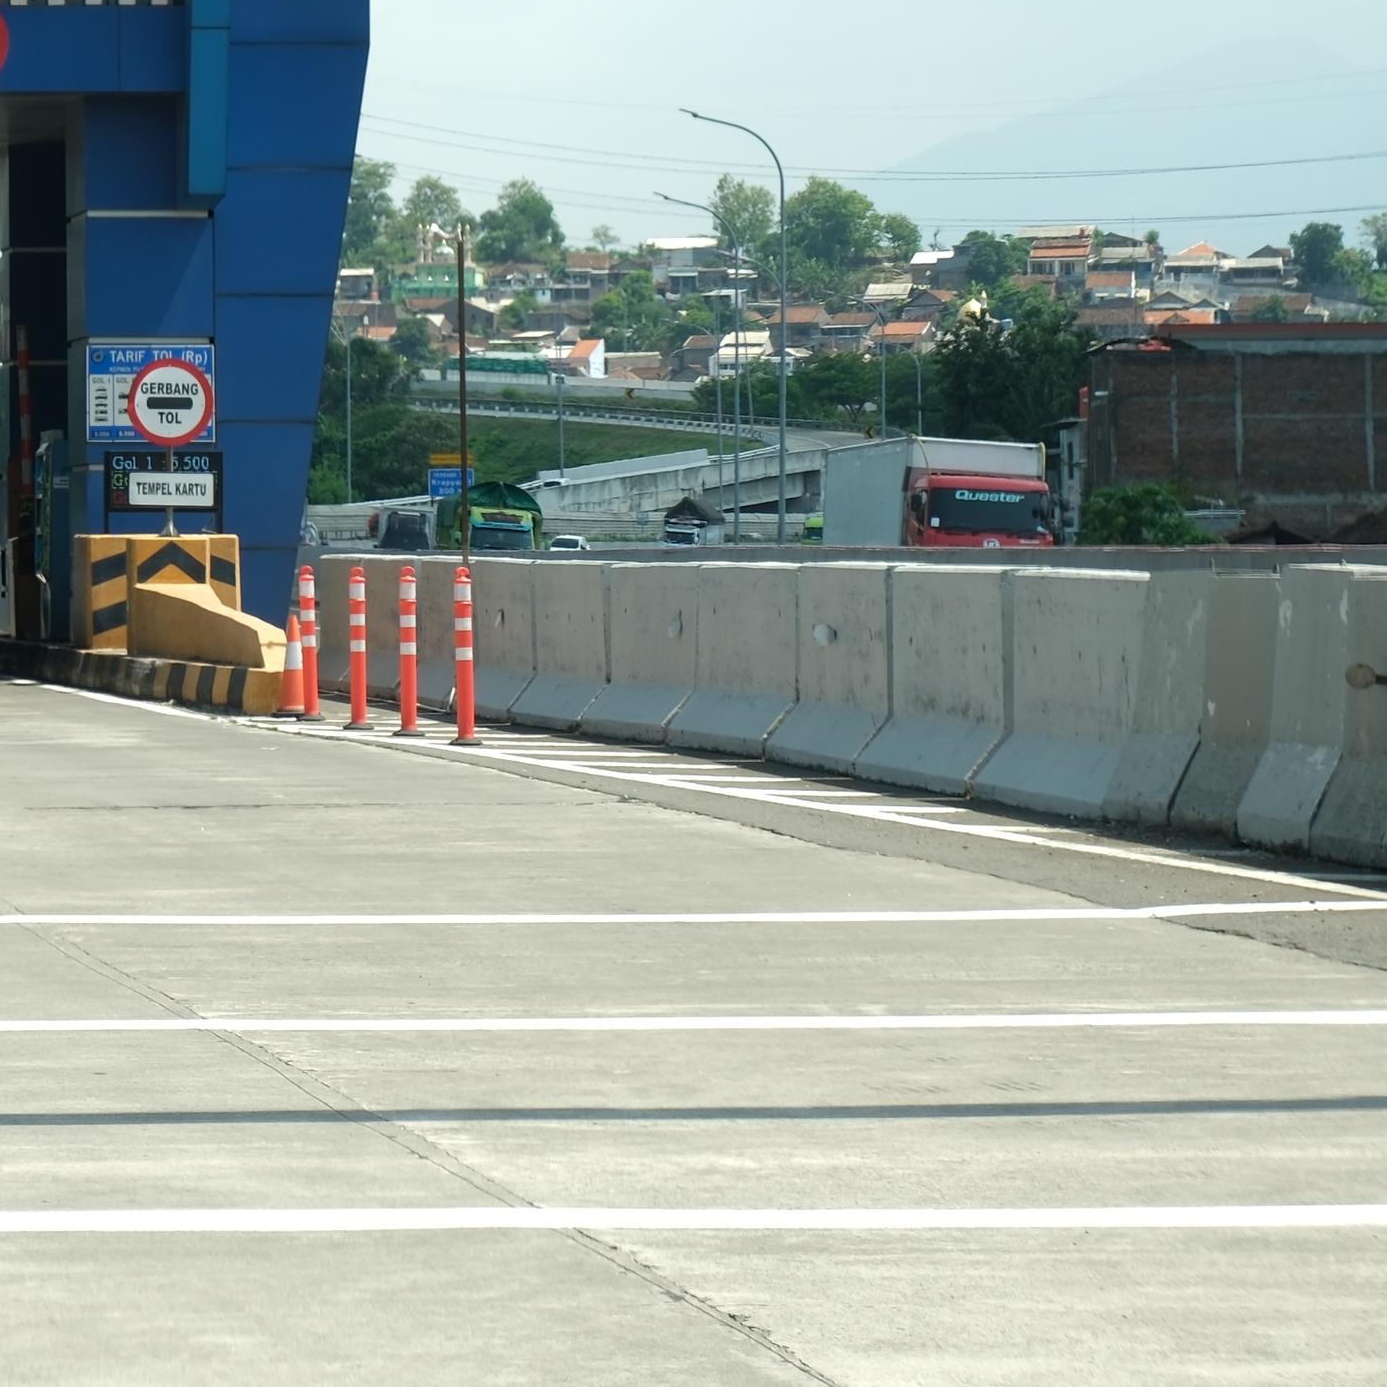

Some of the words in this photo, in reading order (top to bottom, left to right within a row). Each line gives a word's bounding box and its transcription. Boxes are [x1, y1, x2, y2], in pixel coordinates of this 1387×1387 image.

[109, 350, 145, 363] TARIF
[140, 383, 199, 396] GERBANG
[158, 412, 182, 424] TOL
[147, 456, 152, 469] 1
[136, 482, 172, 495] TEMPEL
[175, 483, 207, 496] KARTU
[955, 490, 1025, 503] Quester
